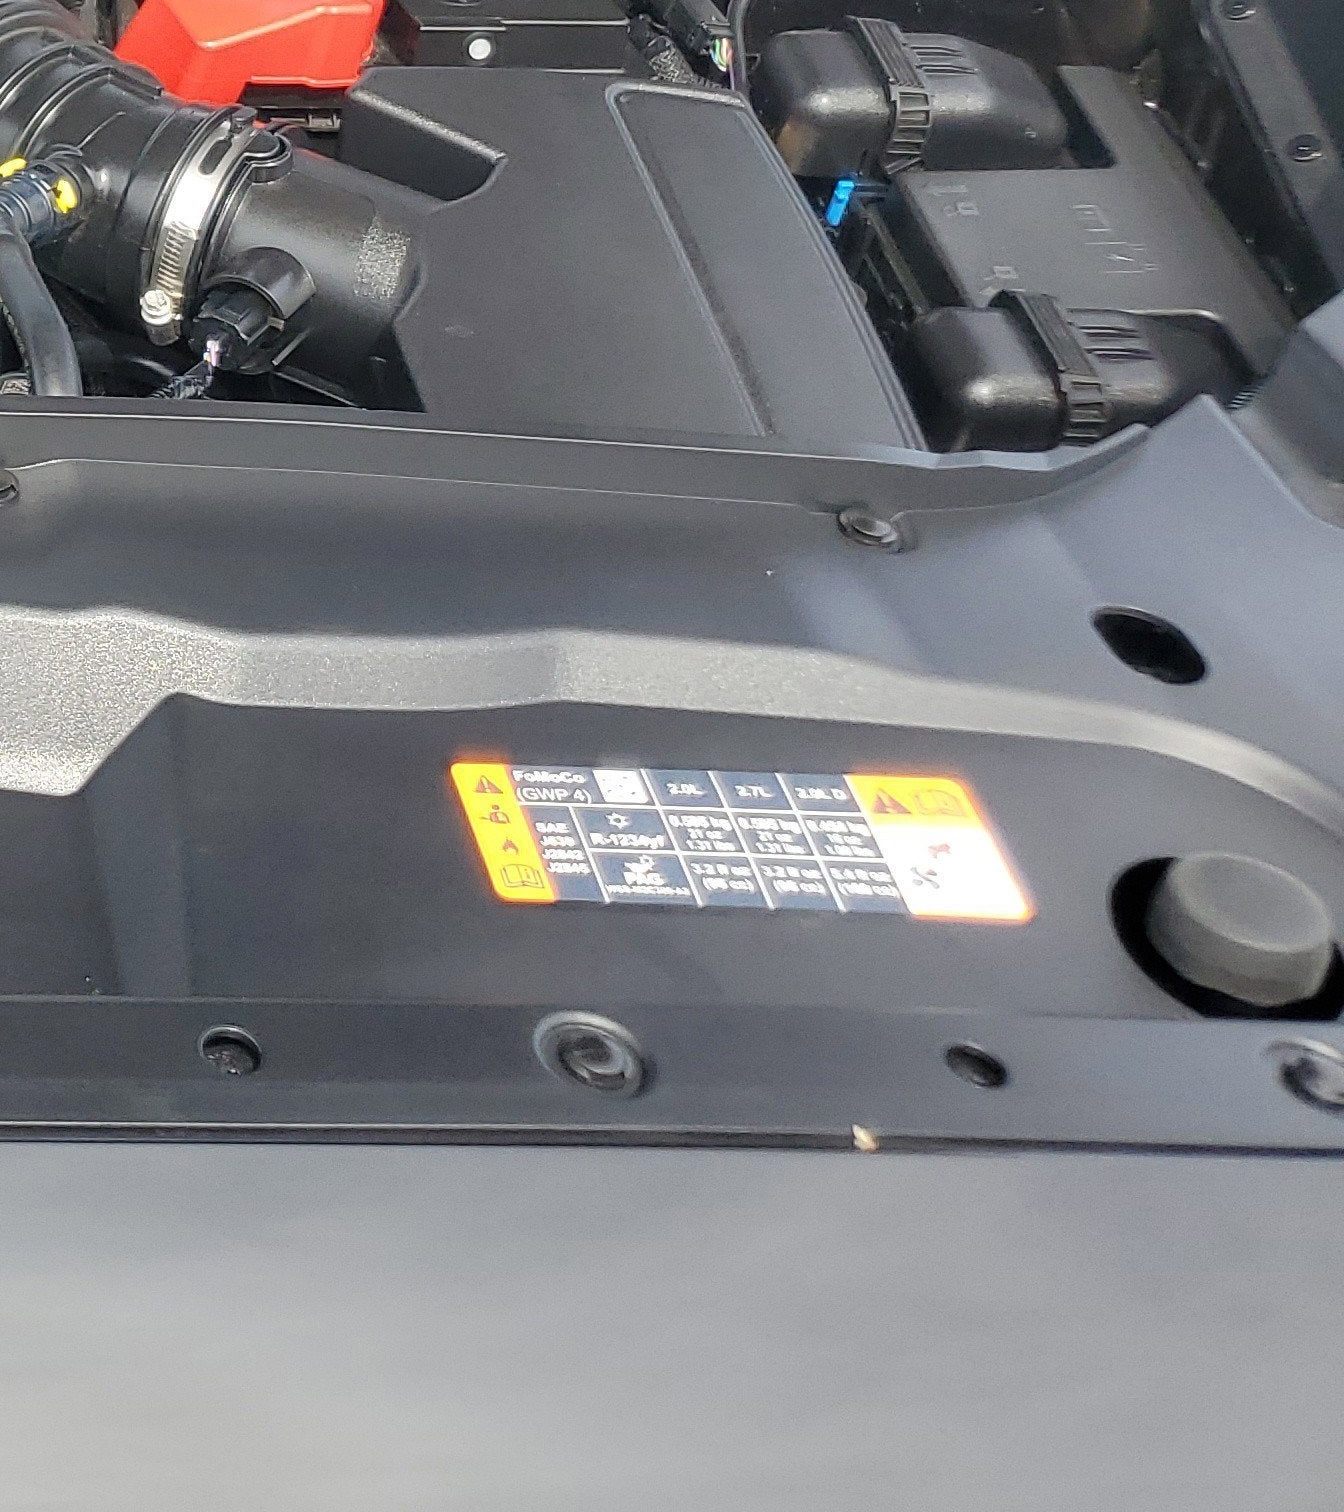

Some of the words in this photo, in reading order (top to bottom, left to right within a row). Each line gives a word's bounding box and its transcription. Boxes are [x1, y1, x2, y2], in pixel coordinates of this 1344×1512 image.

[512, 770, 588, 784] FoMoCo
[515, 787, 569, 803] (GWP
[573, 788, 593, 805] 4)
[734, 785, 774, 798] 2.7L
[535, 822, 570, 834] SAE
[589, 832, 665, 850] R-1234yf
[623, 871, 667, 886] PAG
